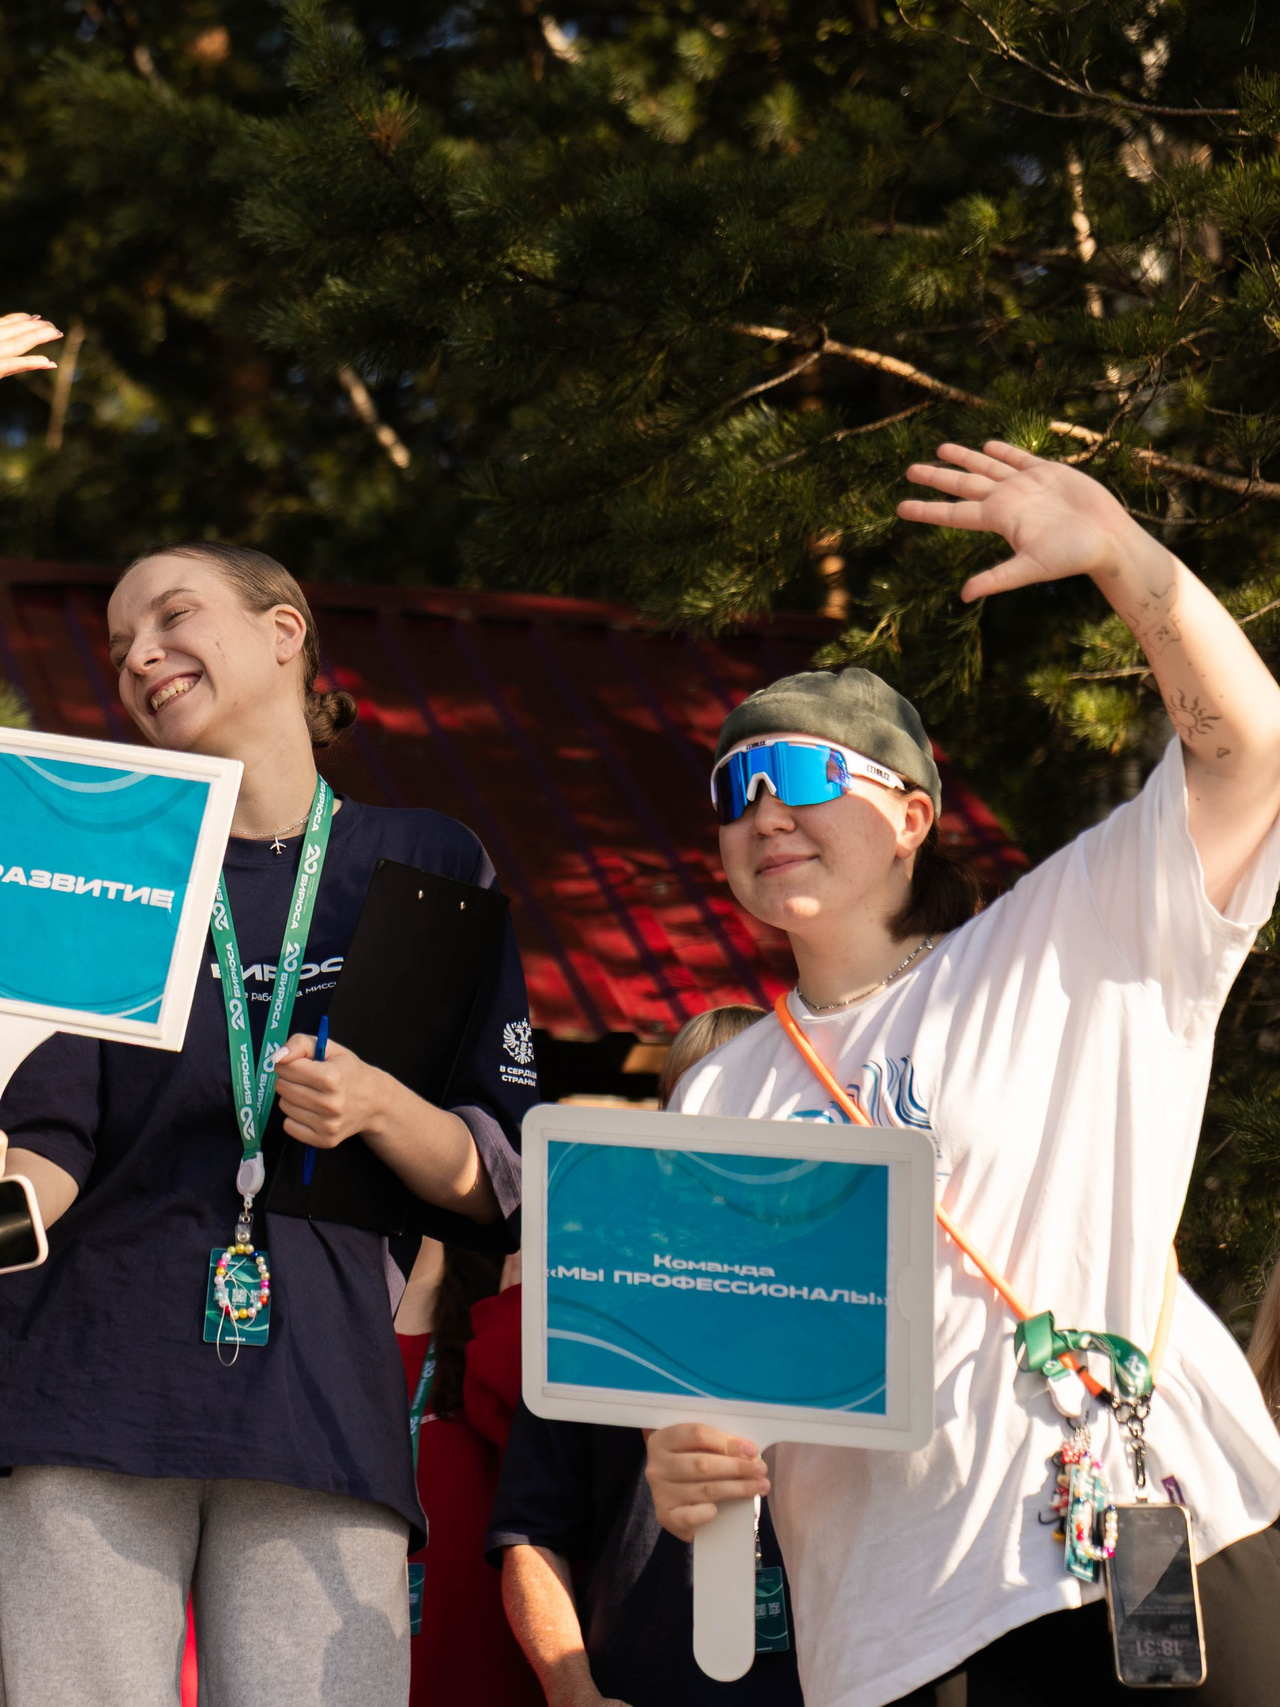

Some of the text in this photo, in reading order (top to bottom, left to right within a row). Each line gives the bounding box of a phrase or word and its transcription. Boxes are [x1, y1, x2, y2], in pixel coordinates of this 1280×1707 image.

[312, 781, 326, 832] БИРЮСА
[290, 874, 309, 930] БИРЮСА
[226, 941, 241, 998] БИРЮСА
[271, 972, 289, 1029] БИРЮСА
[240, 1043, 252, 1104] БИРЮСА
[613, 1270, 888, 1306] ПРОФЕССИОНАЛЫ»
[653, 1254, 775, 1278] Команда
[1135, 1638, 1182, 1657] 18:31
